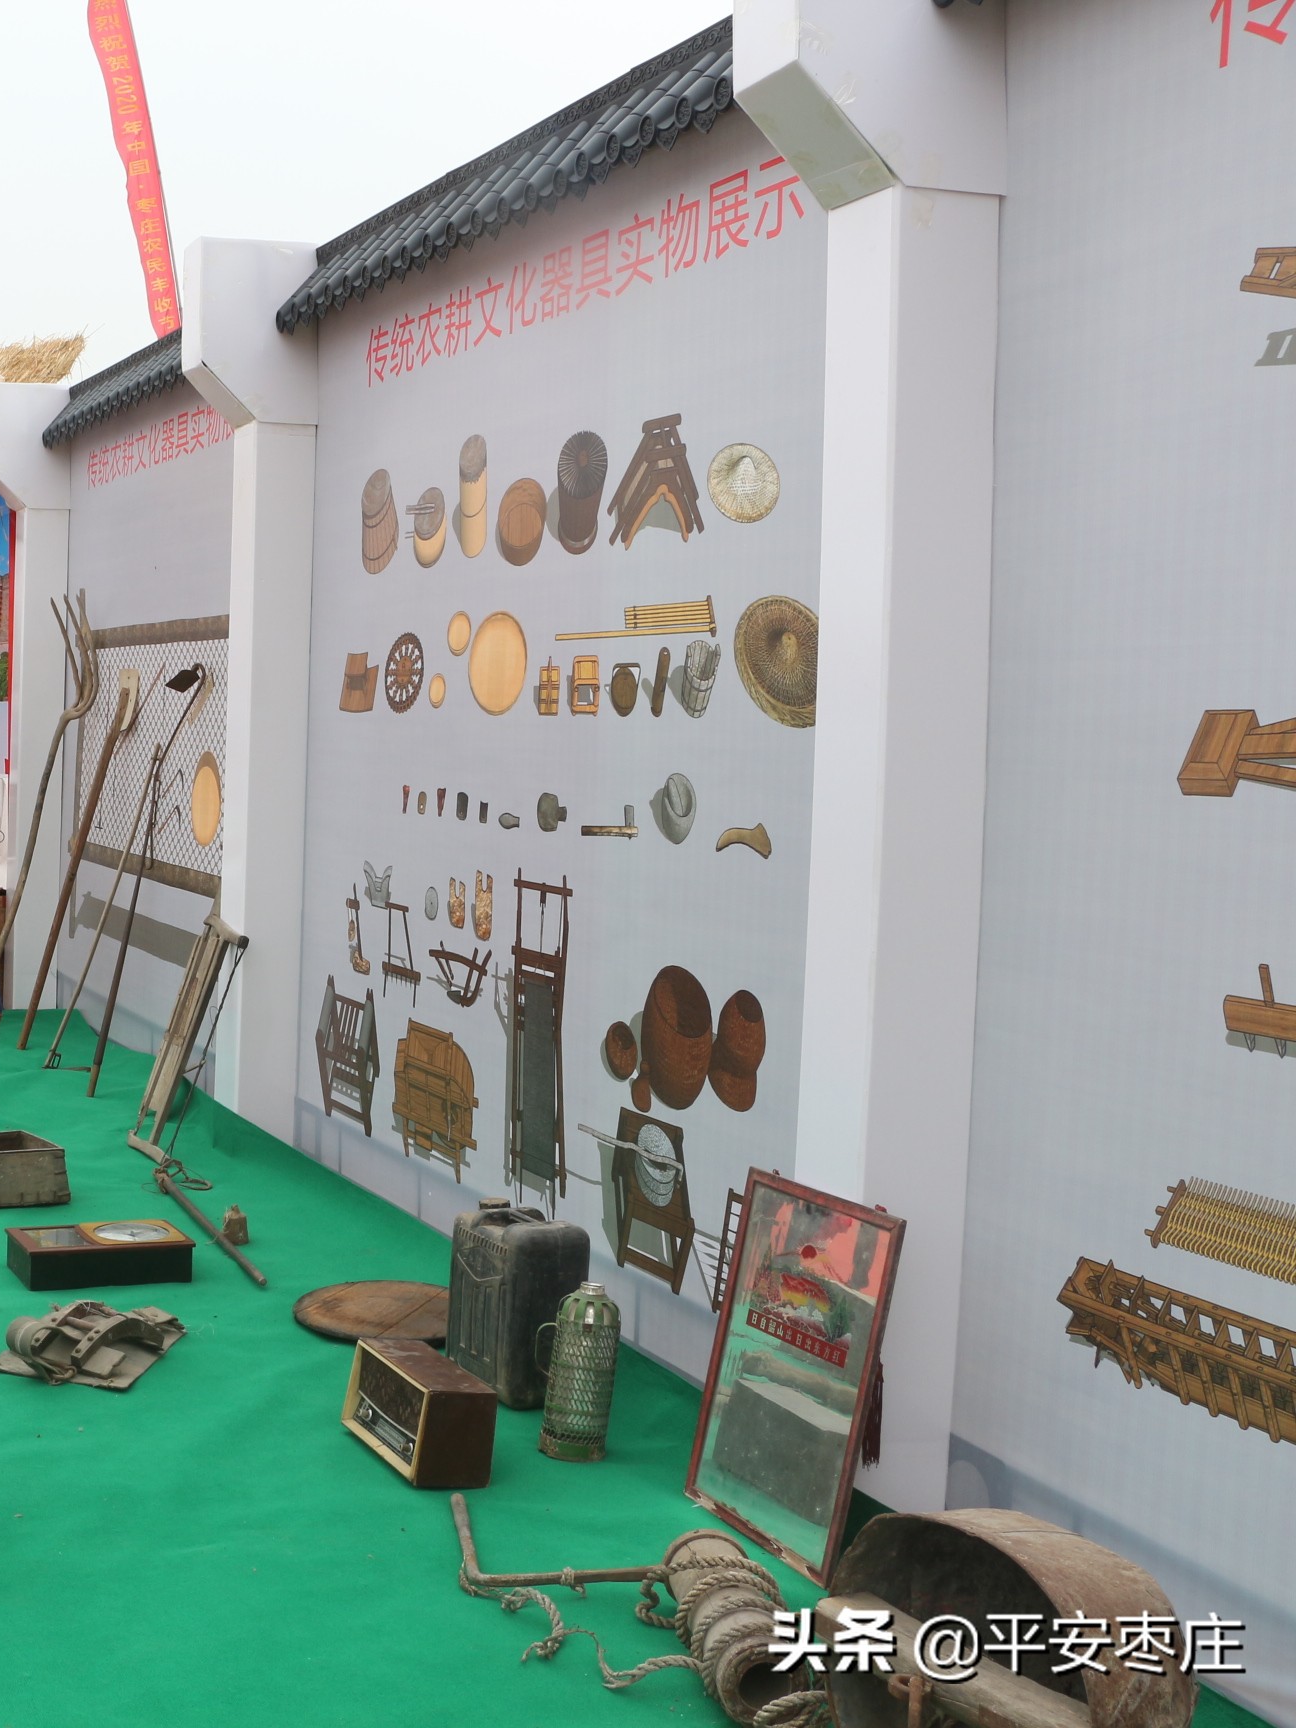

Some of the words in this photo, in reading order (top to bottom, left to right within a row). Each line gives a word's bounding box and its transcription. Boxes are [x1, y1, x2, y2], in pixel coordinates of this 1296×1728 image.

[366, 156, 805, 388] 传统农耕文化器具实物展示
